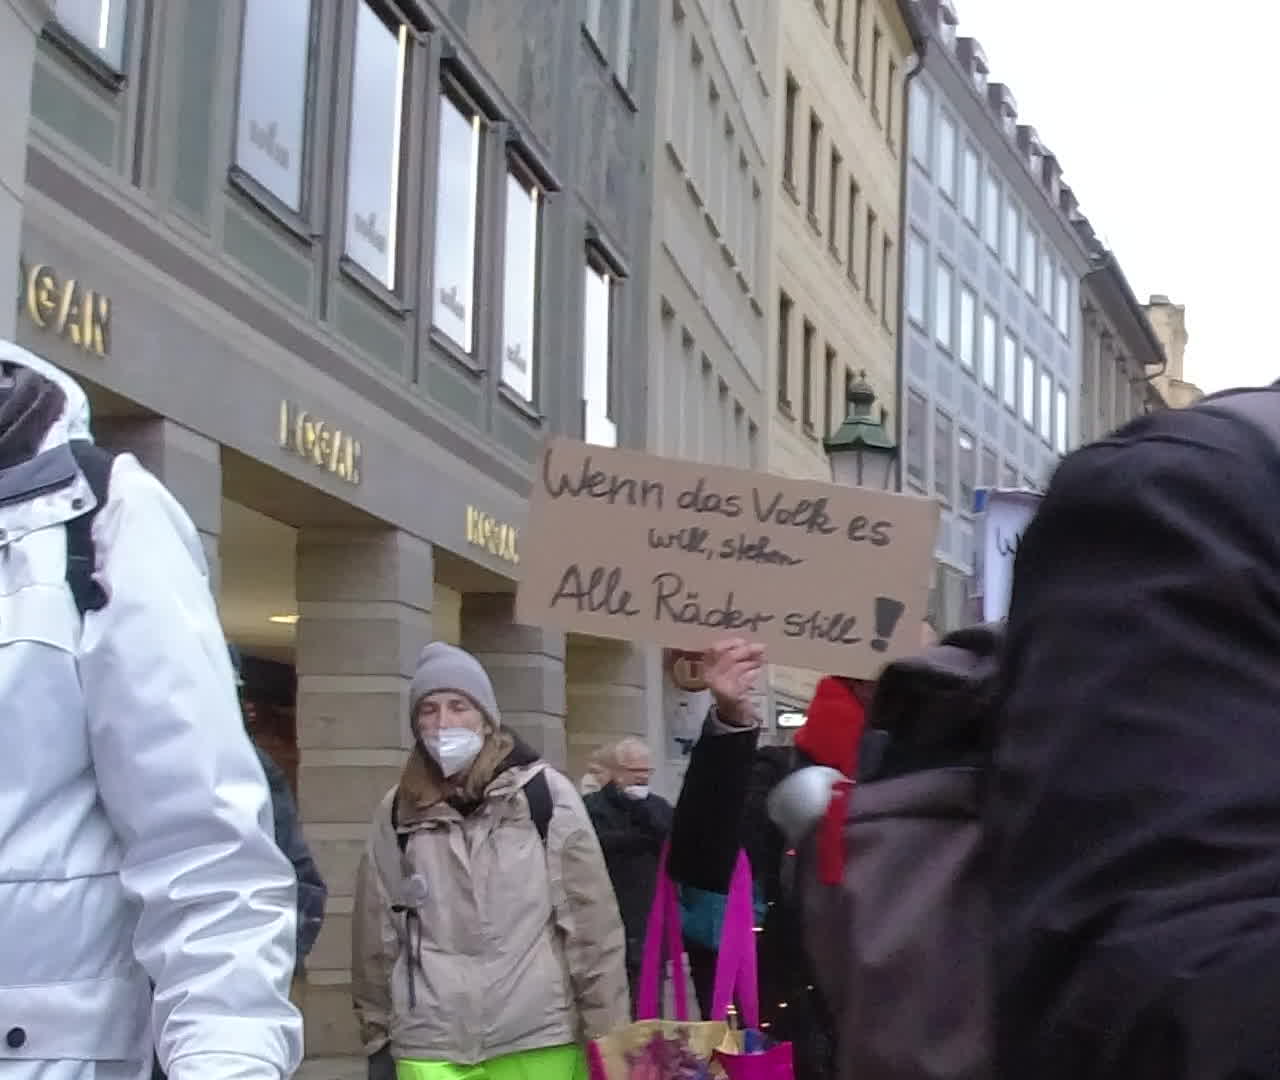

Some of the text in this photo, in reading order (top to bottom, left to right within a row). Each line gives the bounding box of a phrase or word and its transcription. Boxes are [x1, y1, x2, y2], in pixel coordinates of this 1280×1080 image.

[542, 448, 894, 547] Wenn das Volk es
[549, 563, 641, 617] Alle
[651, 571, 775, 632] Räder
